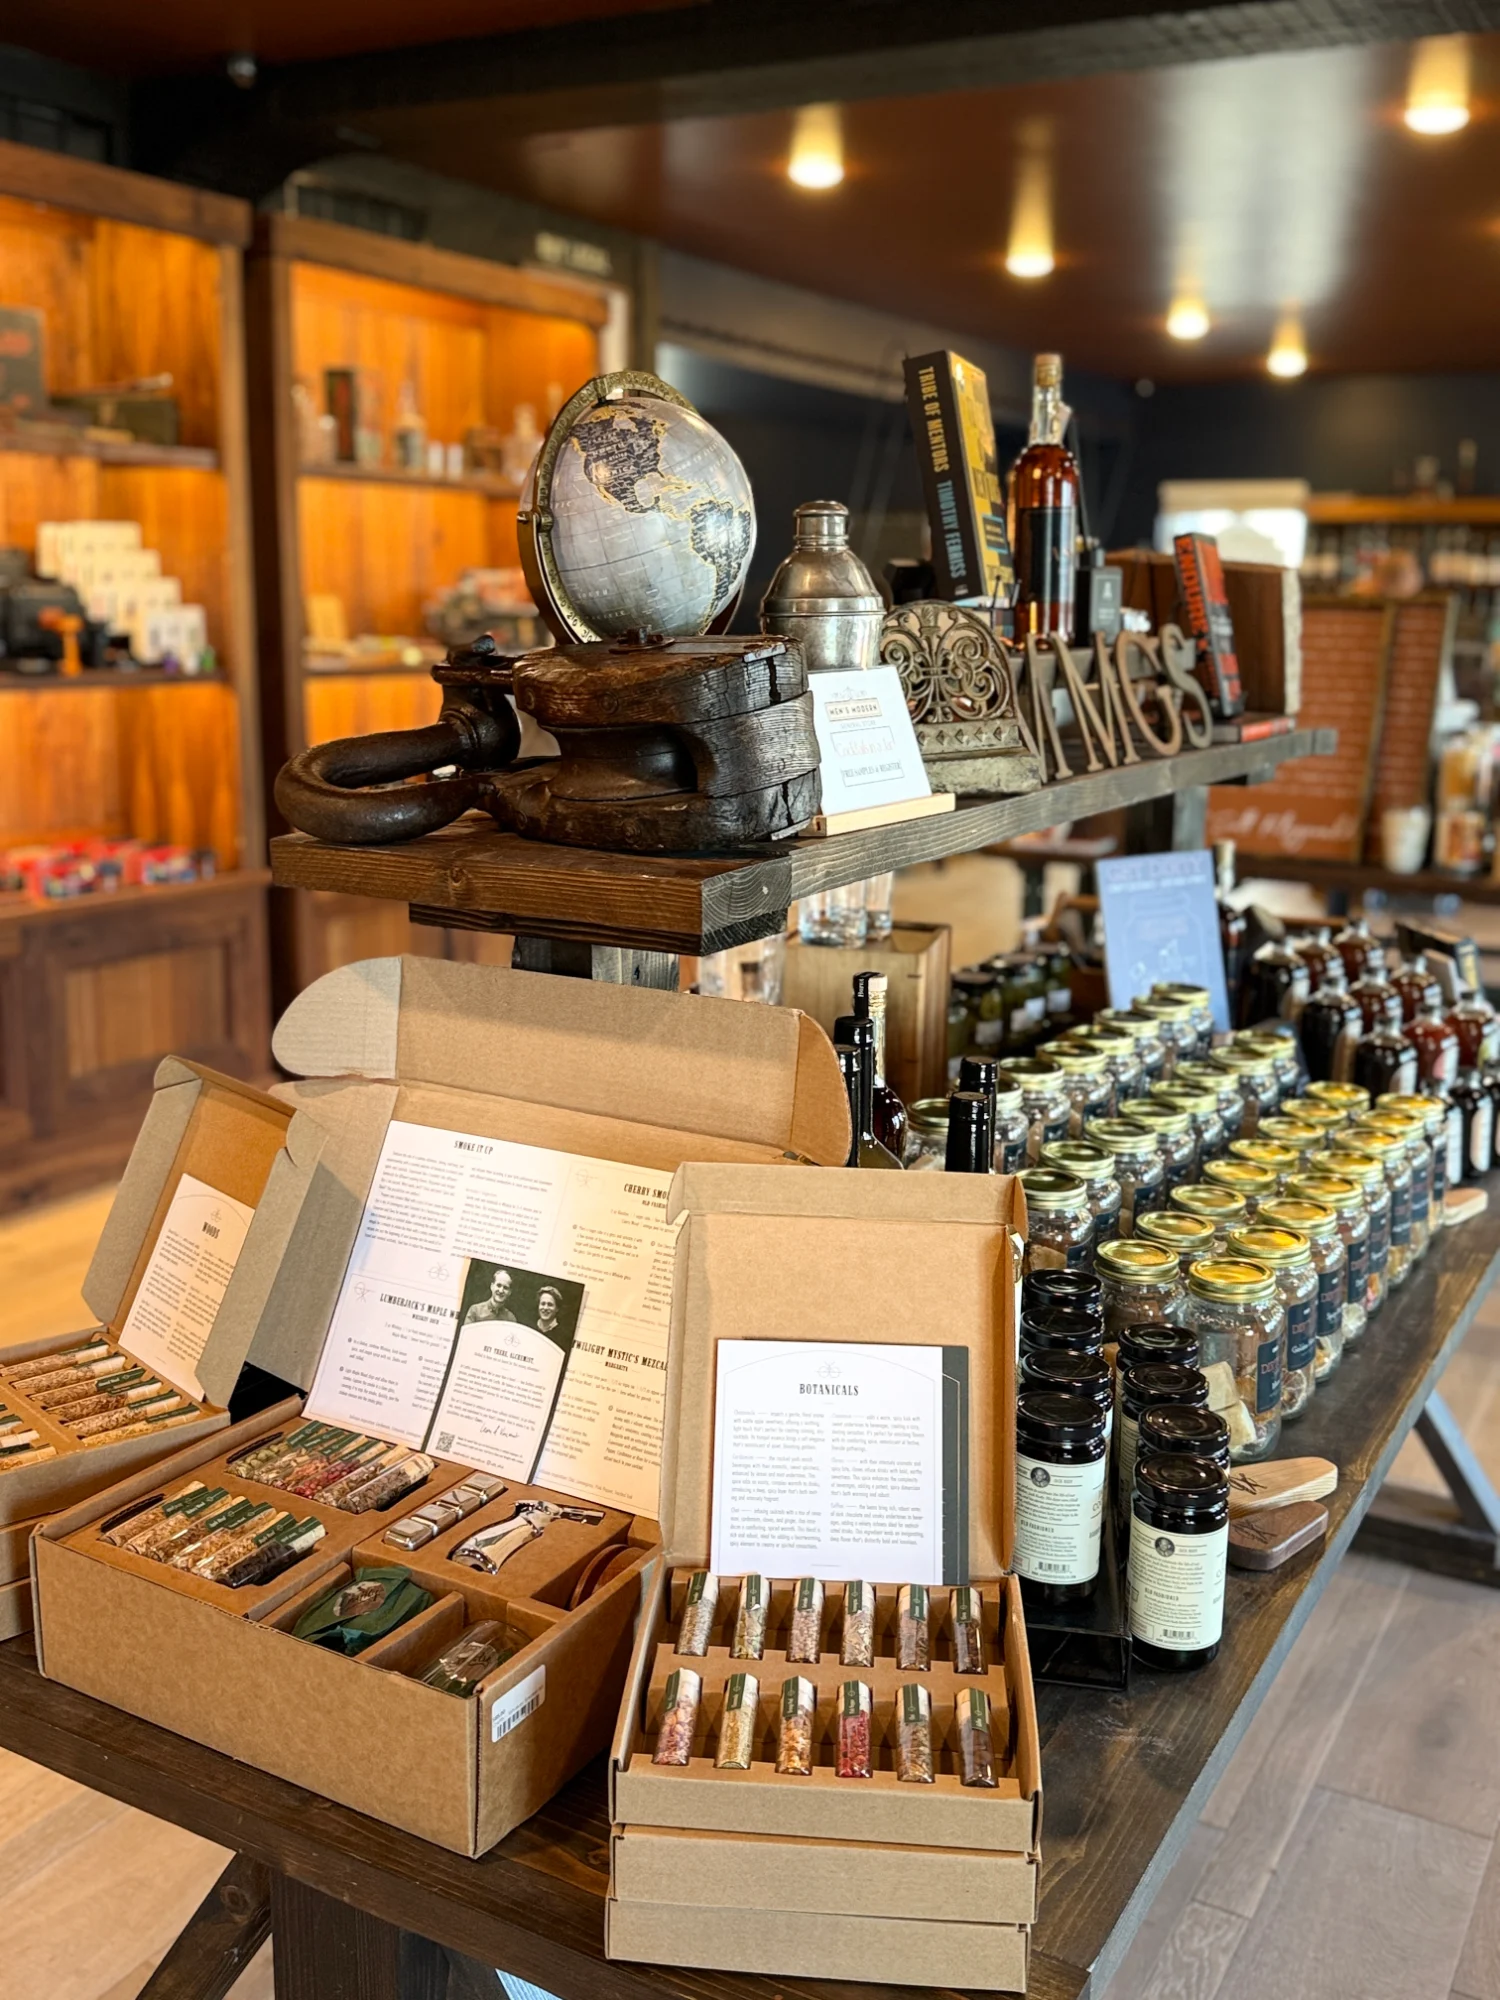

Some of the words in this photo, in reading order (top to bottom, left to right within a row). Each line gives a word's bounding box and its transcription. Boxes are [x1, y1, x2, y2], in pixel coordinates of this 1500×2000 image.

[918, 366, 936, 401] TRIBE
[924, 402, 941, 417] OF
[926, 418, 950, 474] MENTORS
[936, 480, 959, 530] TIMOTHY
[944, 531, 966, 579] FERRISS
[830, 706, 850, 716] MEN'S
[852, 704, 878, 714] MODERN
[454, 1140, 476, 1151] SMOKE
[477, 1144, 484, 1152] IT
[484, 1145, 494, 1155] UP
[624, 1184, 650, 1196] CHERRY
[652, 1189, 669, 1200] SMO
[202, 1221, 220, 1240] WOODS
[380, 1293, 426, 1311] LUMBERJACK'S
[427, 1304, 448, 1316] MAPLE
[608, 1348, 640, 1364] MYSTIC'S
[799, 1383, 859, 1396] BOTANICALS
